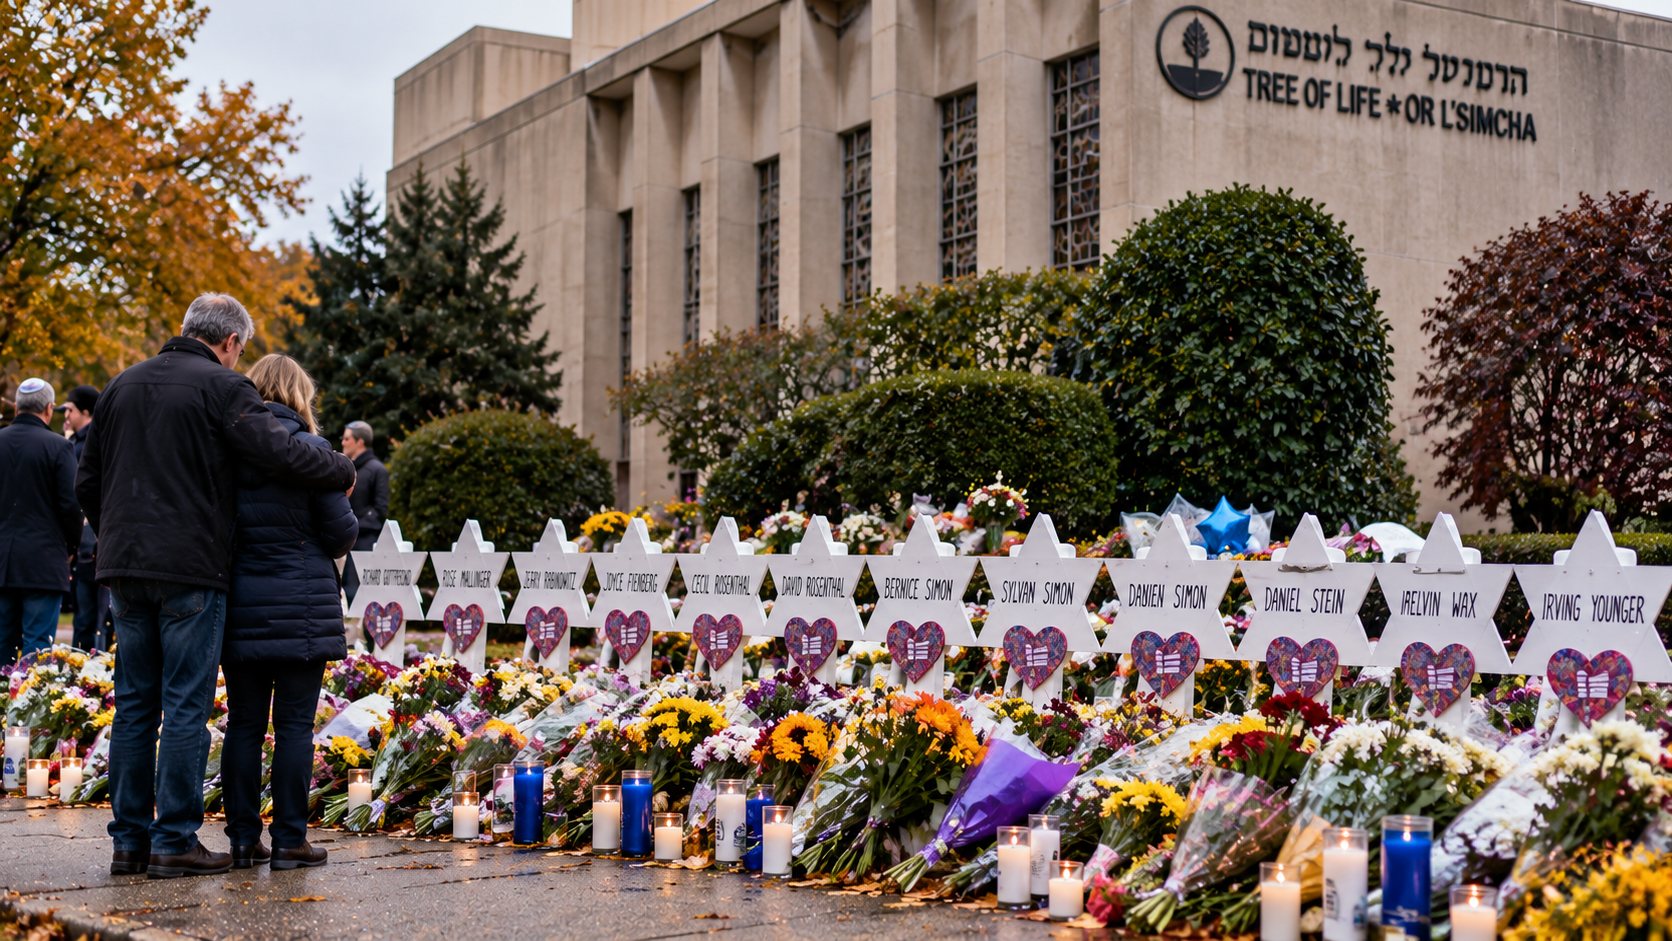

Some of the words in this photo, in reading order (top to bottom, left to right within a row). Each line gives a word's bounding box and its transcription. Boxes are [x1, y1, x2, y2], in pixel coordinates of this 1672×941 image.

[1242, 67, 1299, 106] TREE
[1304, 77, 1332, 109] OF
[1337, 82, 1382, 119] LIFE
[1405, 93, 1435, 127] OR
[1441, 98, 1537, 142] L'SIMCHA
[443, 570, 457, 588] ROSE
[603, 572, 624, 592] JOYCE
[627, 573, 658, 593] FIENBERG
[691, 574, 710, 594] CECIL
[714, 575, 750, 596] ROSENTHAL
[781, 576, 803, 597] DAVID
[806, 576, 845, 598] ROSENTHAL
[884, 577, 920, 600] BERNICE
[924, 578, 954, 601] SIMON
[1001, 580, 1036, 603] SYLVAN
[1043, 581, 1075, 605] SIMON
[1173, 584, 1208, 610] SIMON
[1265, 587, 1302, 613] DANIEL
[1311, 588, 1345, 614] STEIN
[1452, 591, 1478, 619] WAX
[1542, 593, 1581, 622] IRVING
[1592, 594, 1645, 624] YOUNGER
